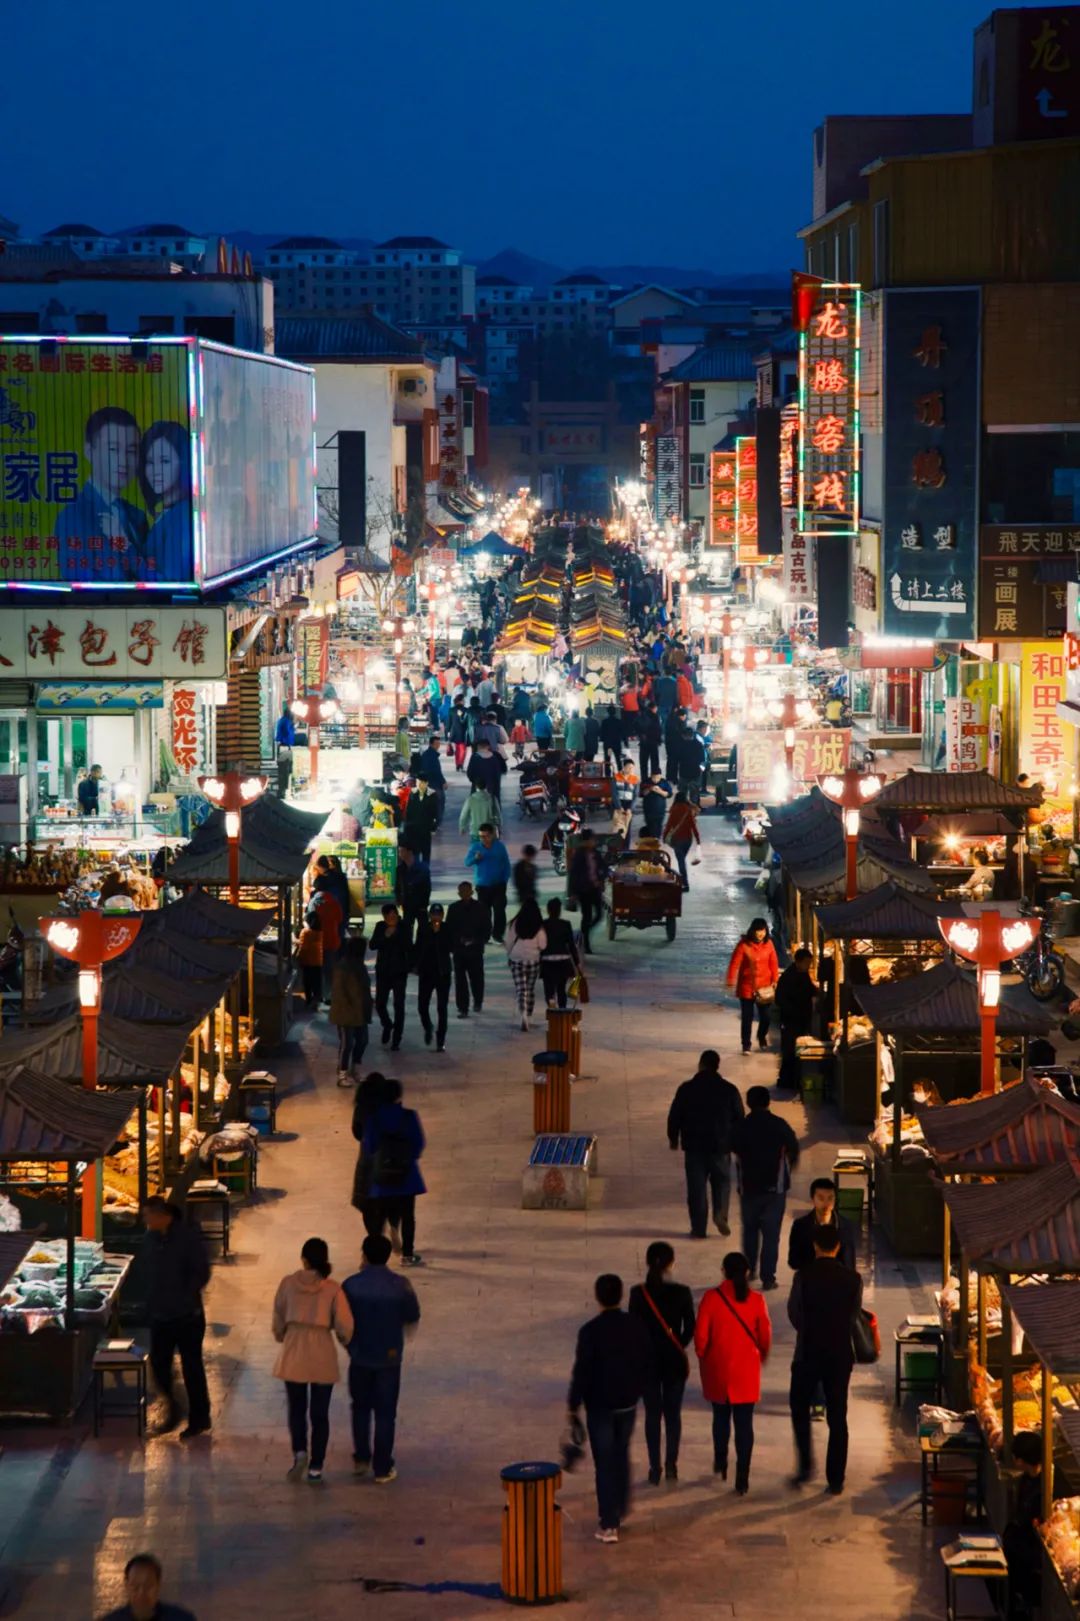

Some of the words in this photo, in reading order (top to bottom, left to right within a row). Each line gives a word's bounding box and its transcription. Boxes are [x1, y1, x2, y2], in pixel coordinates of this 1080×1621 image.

[4, 451, 79, 503] 家居
[901, 524, 953, 550] 造型
[907, 577, 967, 601] 请上二楼
[994, 582, 1018, 632] 画展
[173, 689, 197, 774] 夜光杯
